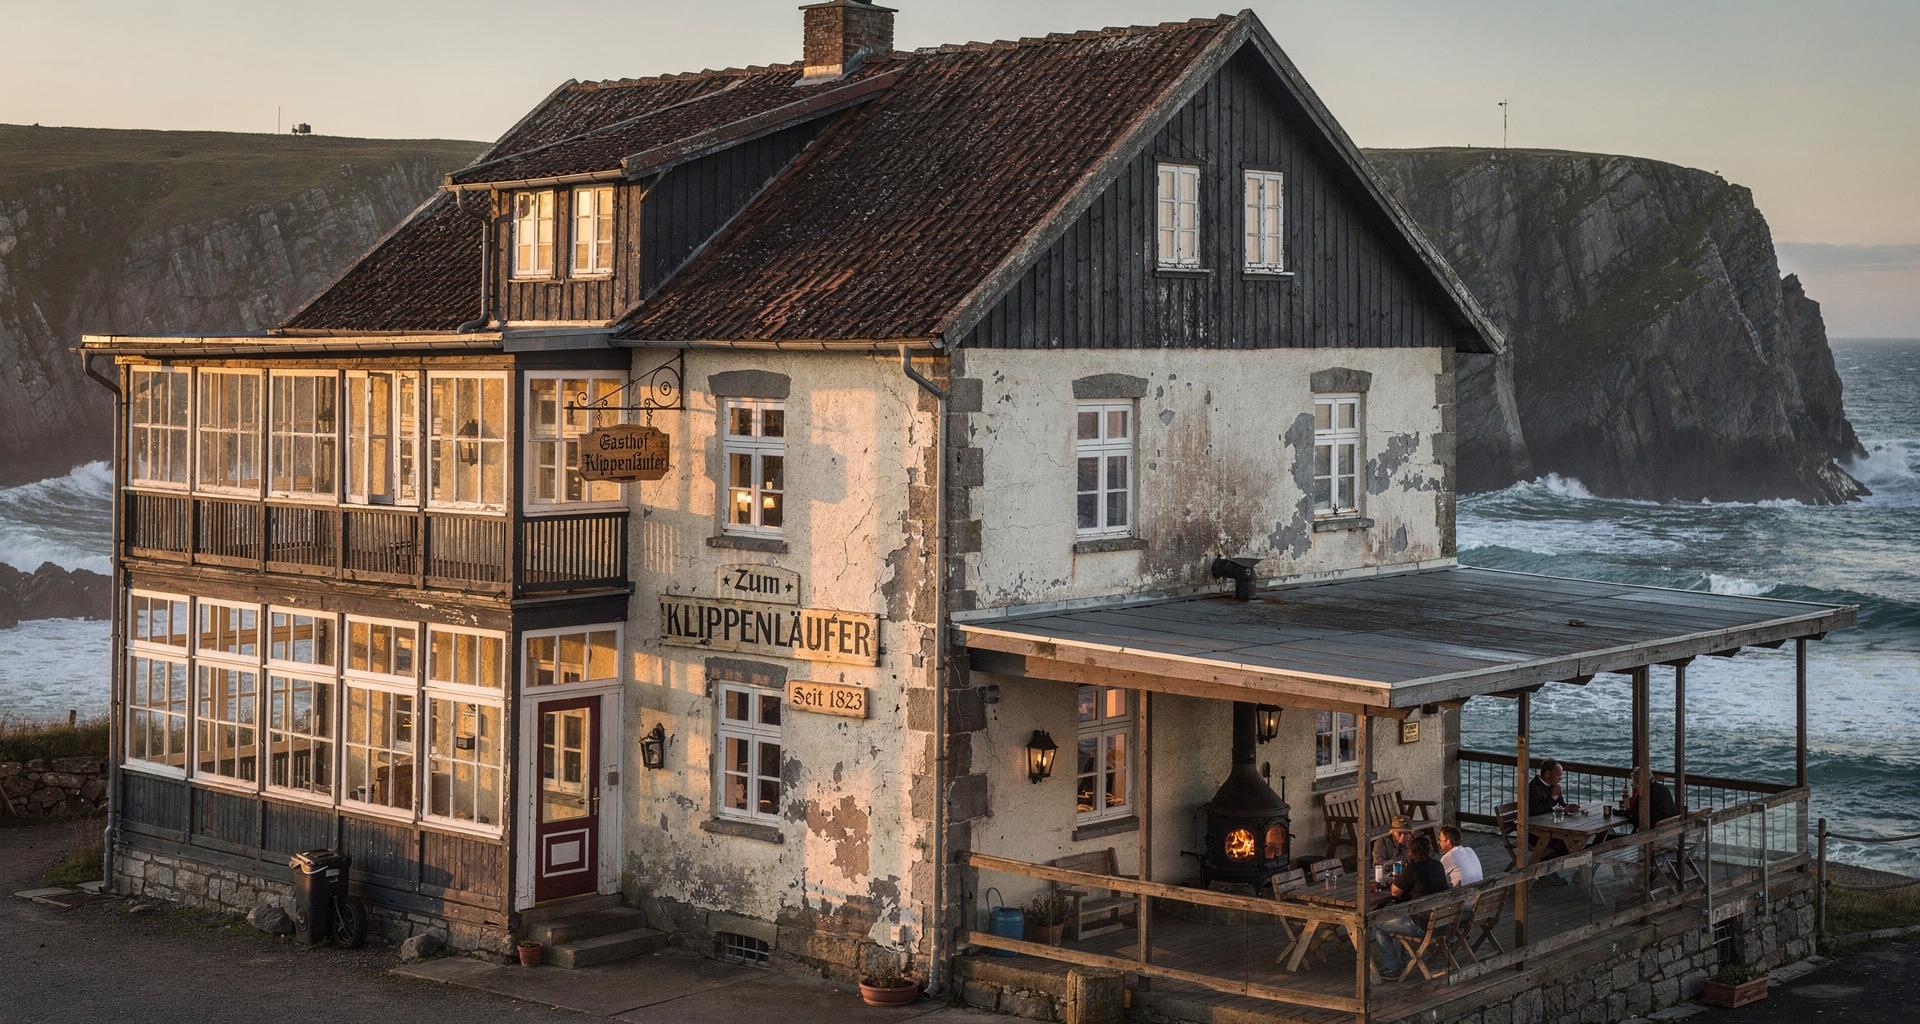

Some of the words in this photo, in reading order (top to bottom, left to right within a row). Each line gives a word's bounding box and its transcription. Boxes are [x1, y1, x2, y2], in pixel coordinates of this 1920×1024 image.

[600, 432, 650, 451] Gasthof
[734, 568, 780, 594] Zum
[667, 602, 870, 657] KLIPPENLÄUFER
[792, 687, 823, 707] Seit
[830, 690, 862, 710] 1823
